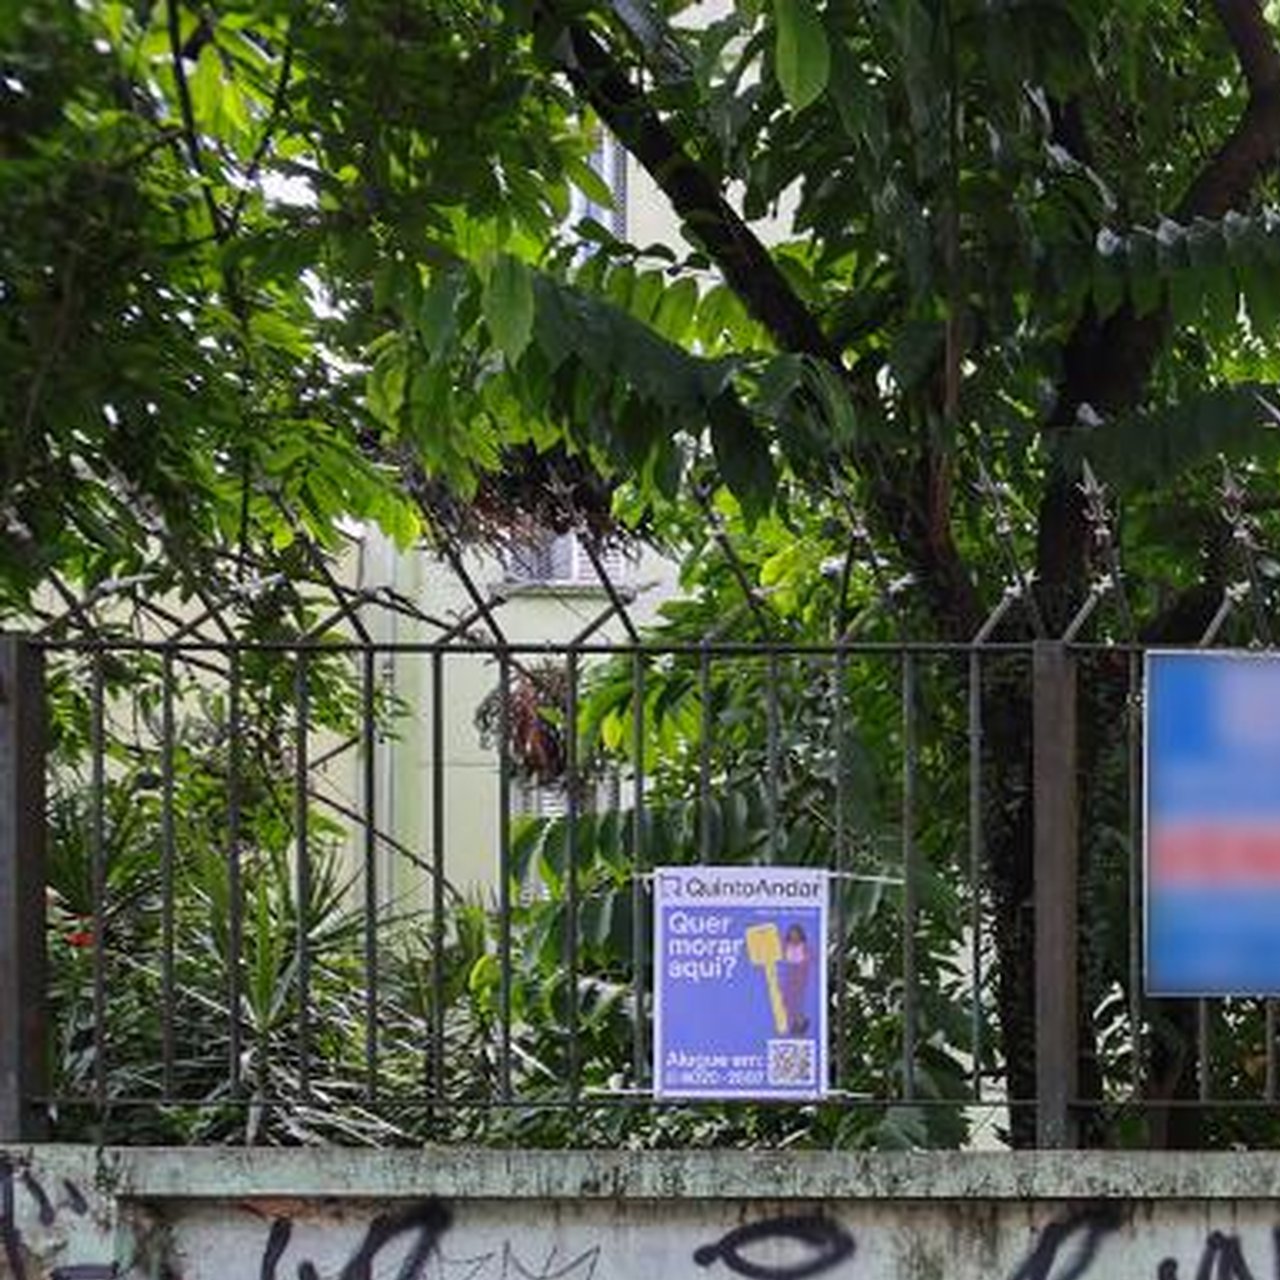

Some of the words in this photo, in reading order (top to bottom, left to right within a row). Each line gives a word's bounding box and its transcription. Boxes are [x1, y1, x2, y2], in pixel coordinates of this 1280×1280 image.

[686, 878, 821, 898] QuintoAndar
[668, 912, 731, 934] Quer
[668, 939, 743, 956] morar
[667, 956, 737, 981] aqui?
